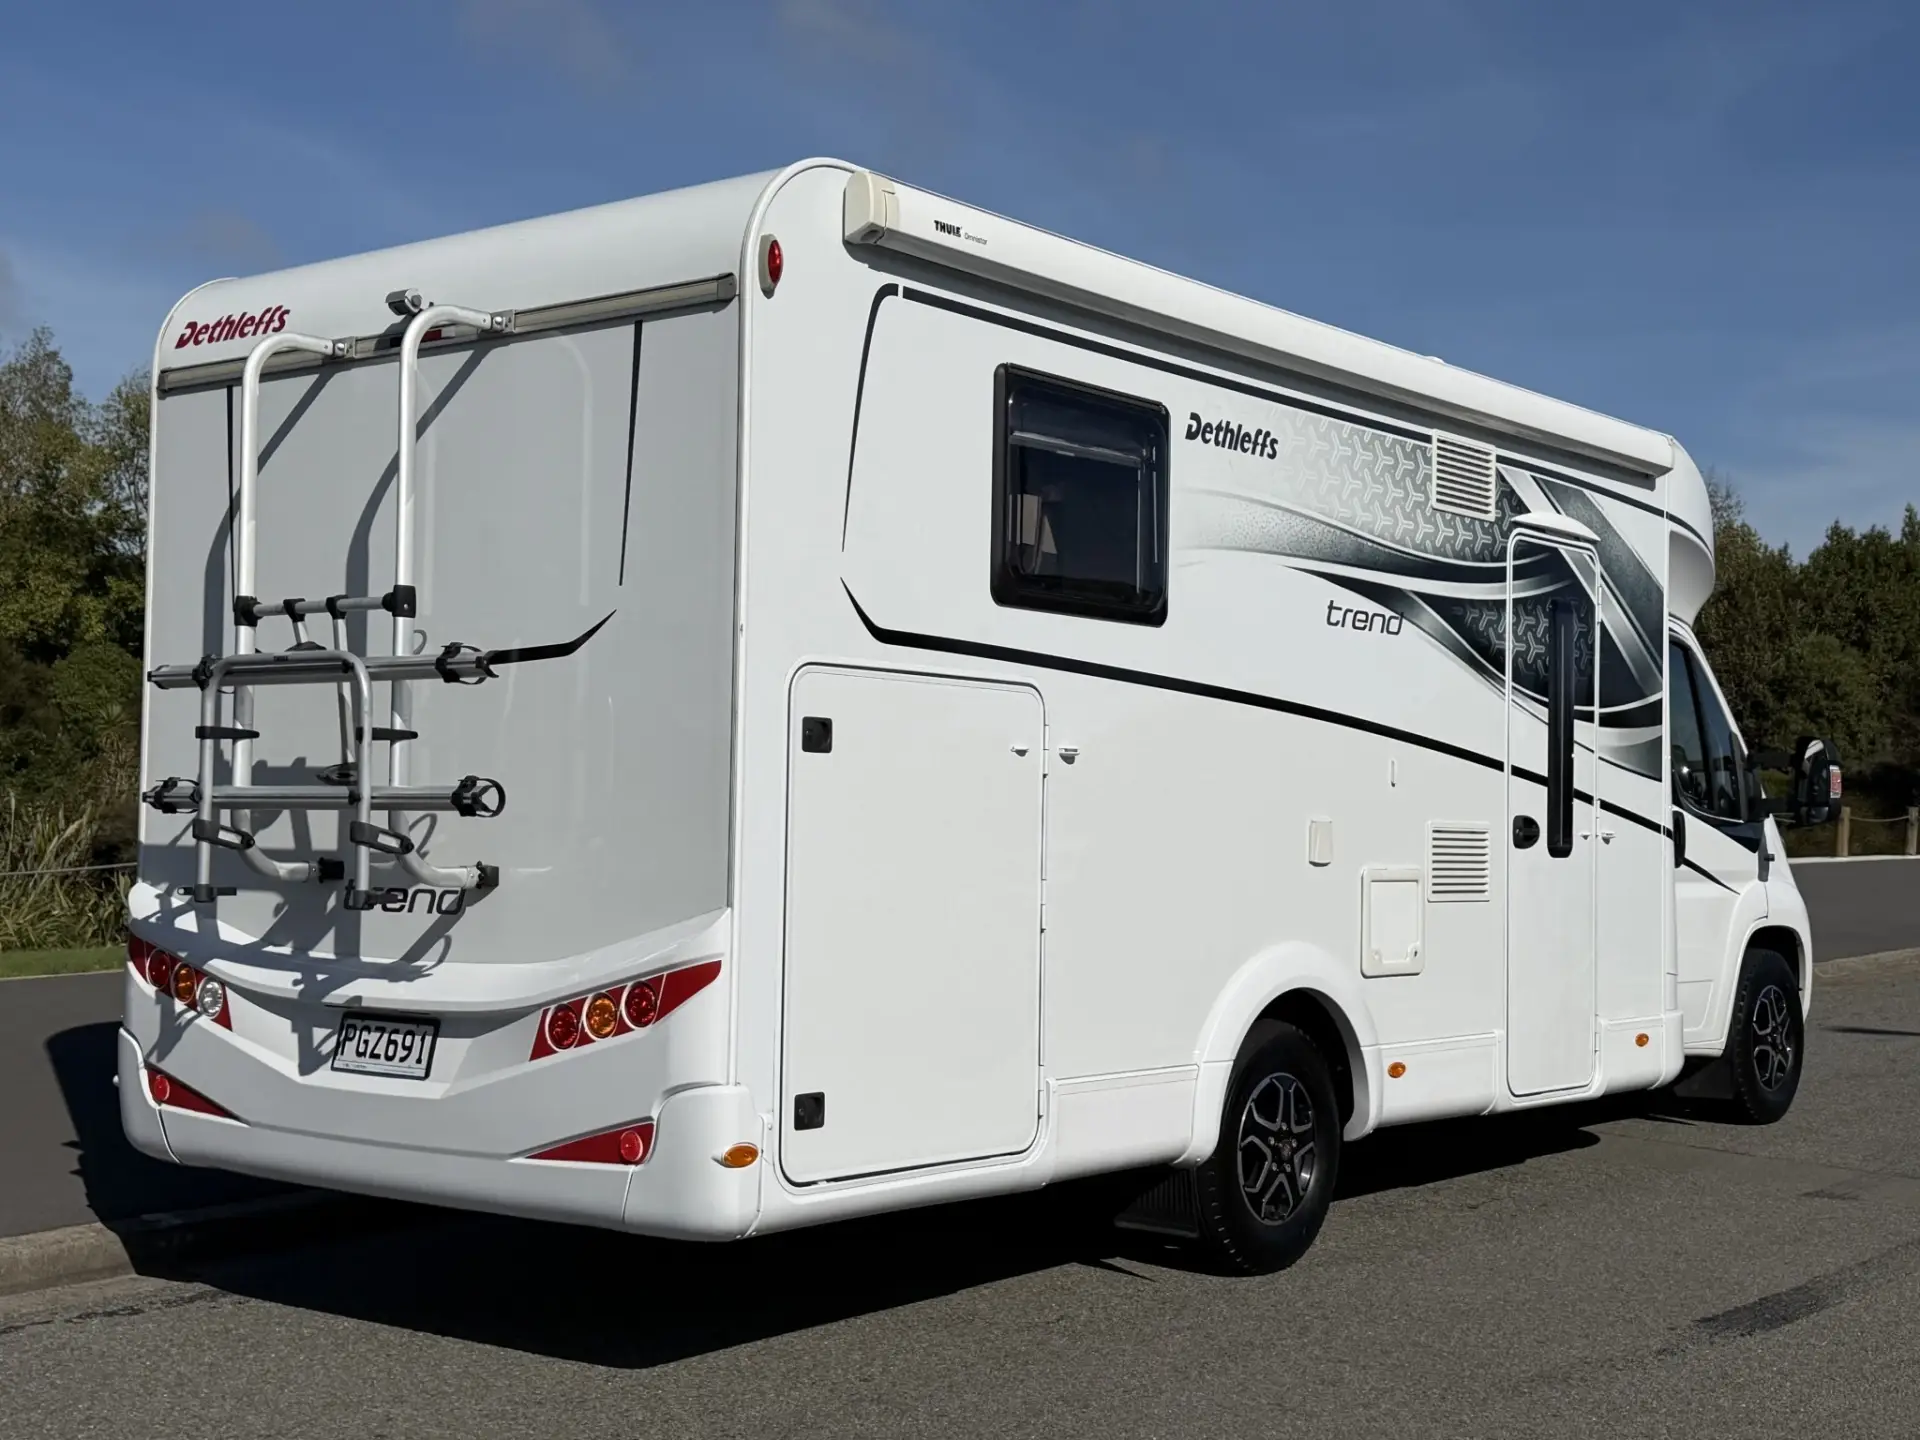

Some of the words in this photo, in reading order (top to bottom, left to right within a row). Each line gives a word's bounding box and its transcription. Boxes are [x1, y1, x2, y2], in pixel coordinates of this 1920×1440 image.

[934, 219, 962, 238] THULE
[174, 304, 291, 349] Dethleffs
[1184, 411, 1279, 460] Dethleffs
[1326, 599, 1405, 636] trend
[340, 1023, 428, 1065] PGZ691
